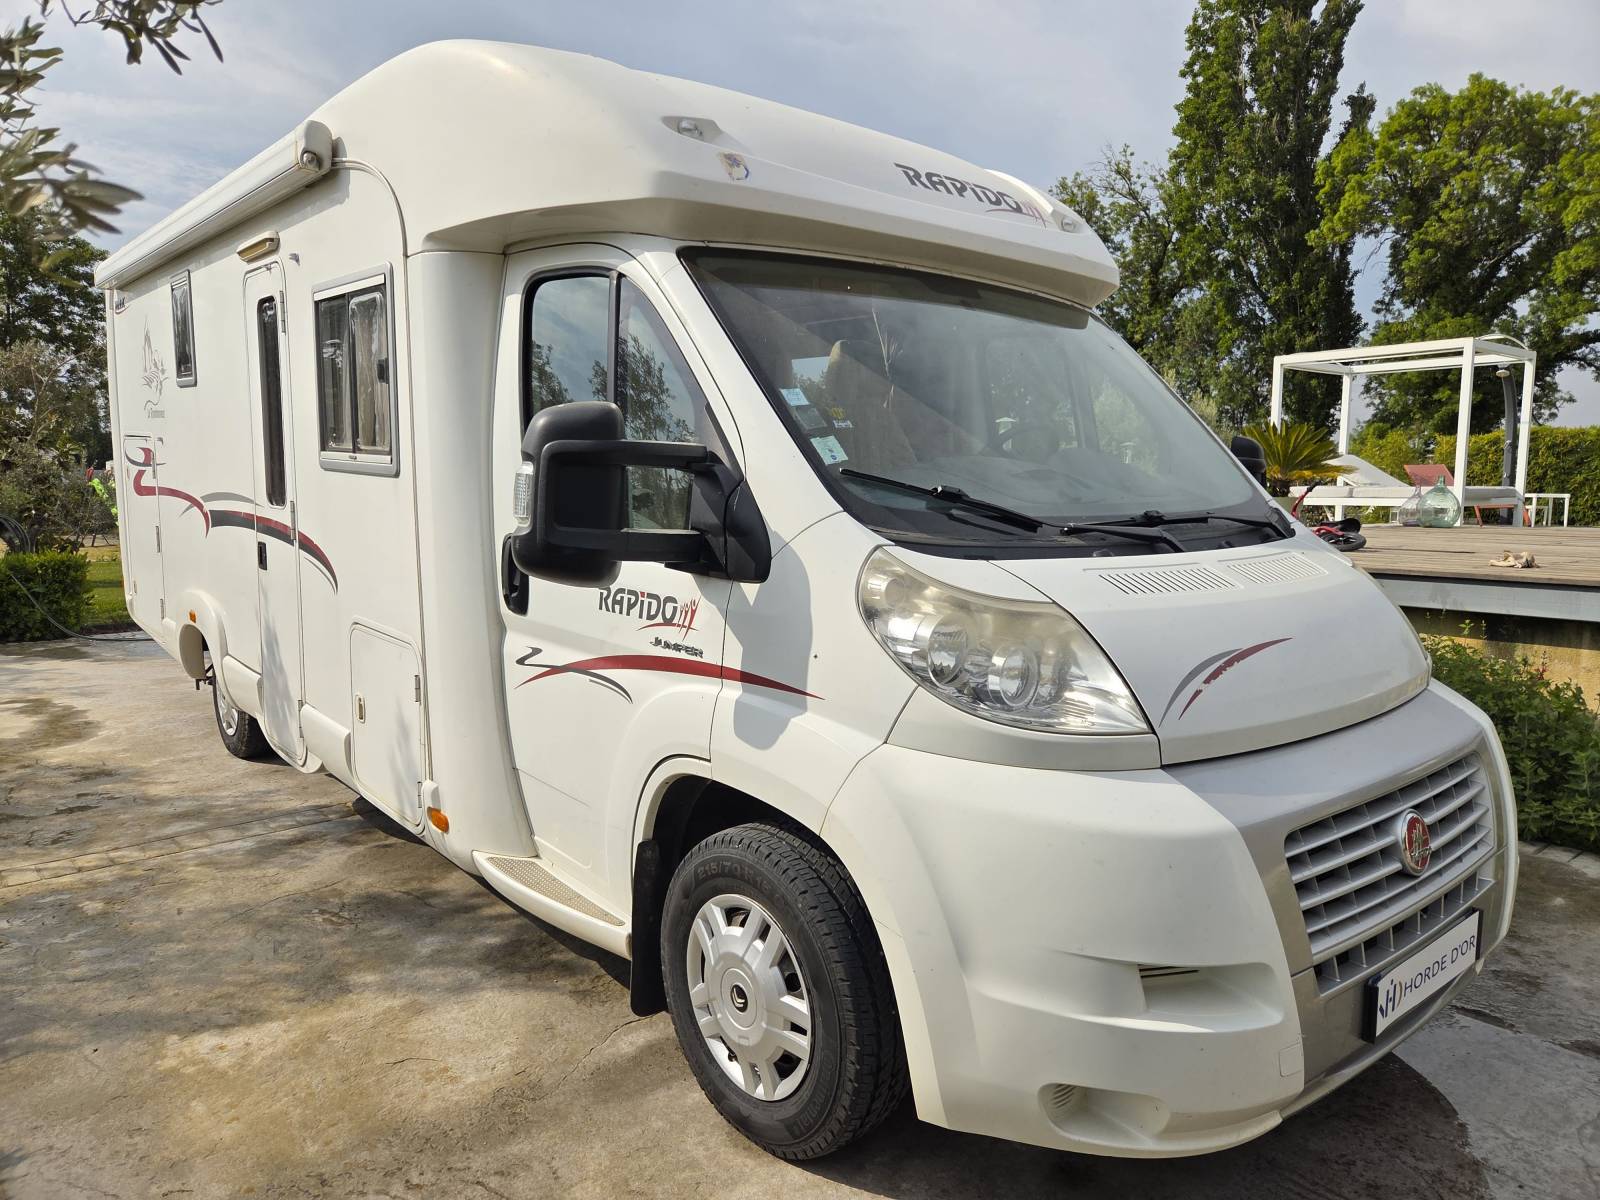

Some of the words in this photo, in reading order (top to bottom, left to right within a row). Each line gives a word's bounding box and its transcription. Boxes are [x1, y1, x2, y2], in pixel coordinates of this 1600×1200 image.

[649, 636, 704, 659] JUMPER
[1403, 954, 1448, 997] HORDE
[1451, 935, 1476, 965] D'OR
